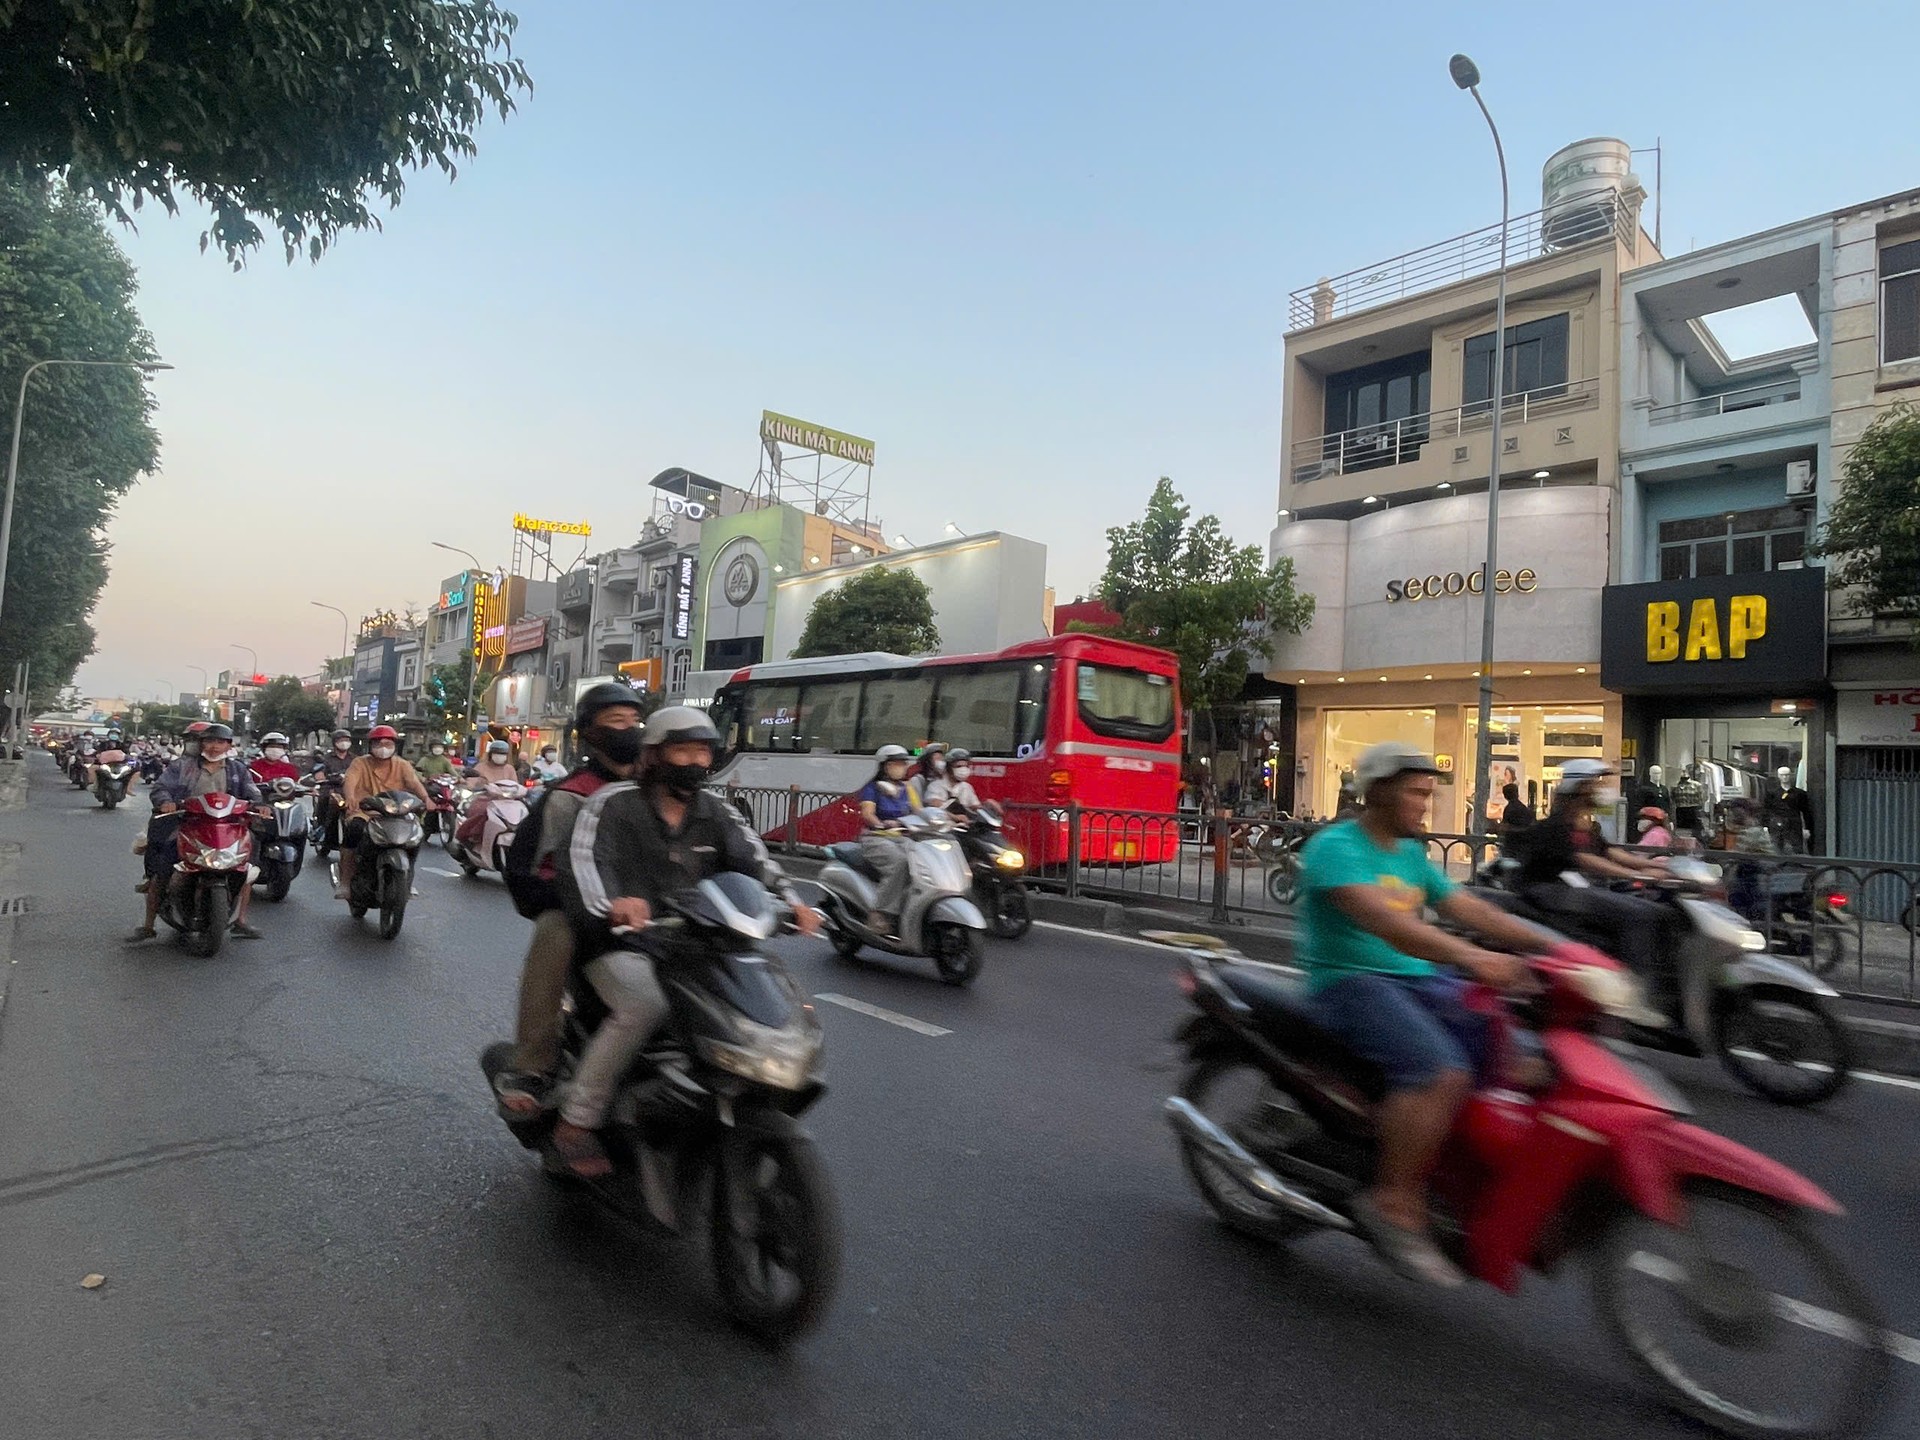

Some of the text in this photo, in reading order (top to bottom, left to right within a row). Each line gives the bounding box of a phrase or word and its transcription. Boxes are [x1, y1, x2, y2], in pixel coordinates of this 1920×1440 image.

[765, 418, 802, 443] KÍNH
[838, 440, 874, 463] ANNA
[513, 512, 592, 536] Hancook
[676, 558, 692, 637] KÍNH MẮT ANNA
[1386, 562, 1538, 602] secodee
[1646, 595, 1767, 662] BAP
[1438, 759, 1451, 769] 89
